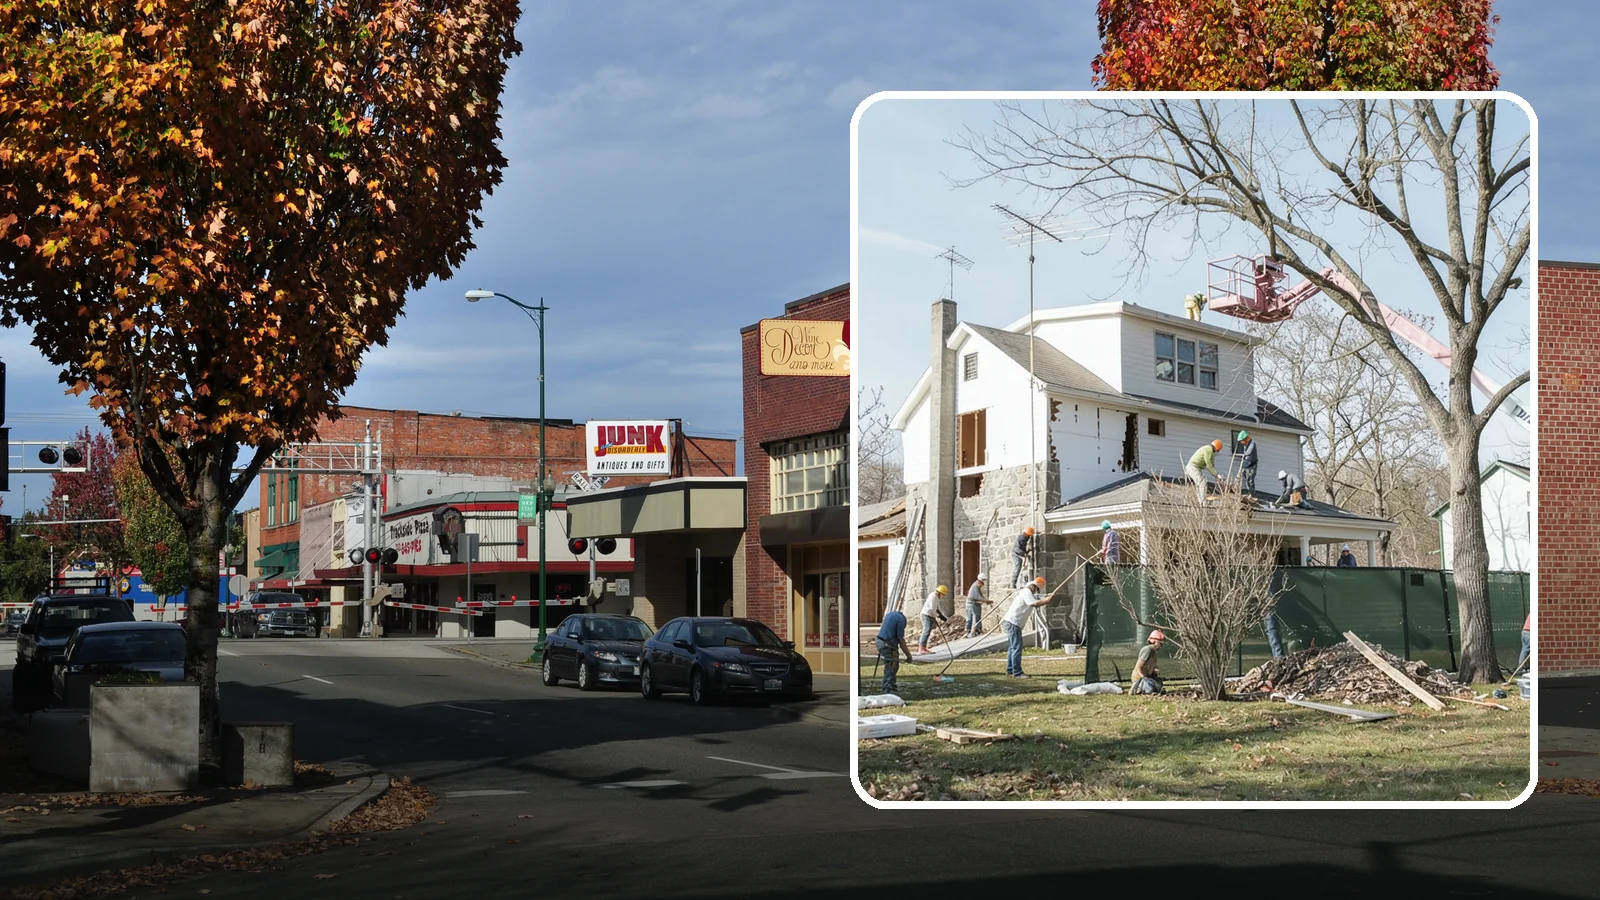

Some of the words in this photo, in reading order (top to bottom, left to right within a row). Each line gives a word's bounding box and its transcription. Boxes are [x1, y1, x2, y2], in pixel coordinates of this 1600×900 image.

[595, 425, 665, 457] JUNK
[607, 446, 646, 454] DISORDERLY
[597, 461, 628, 470] ANTIQUES
[631, 461, 643, 470] AND
[647, 460, 665, 470] GIFTS
[414, 519, 429, 535] Pizza
